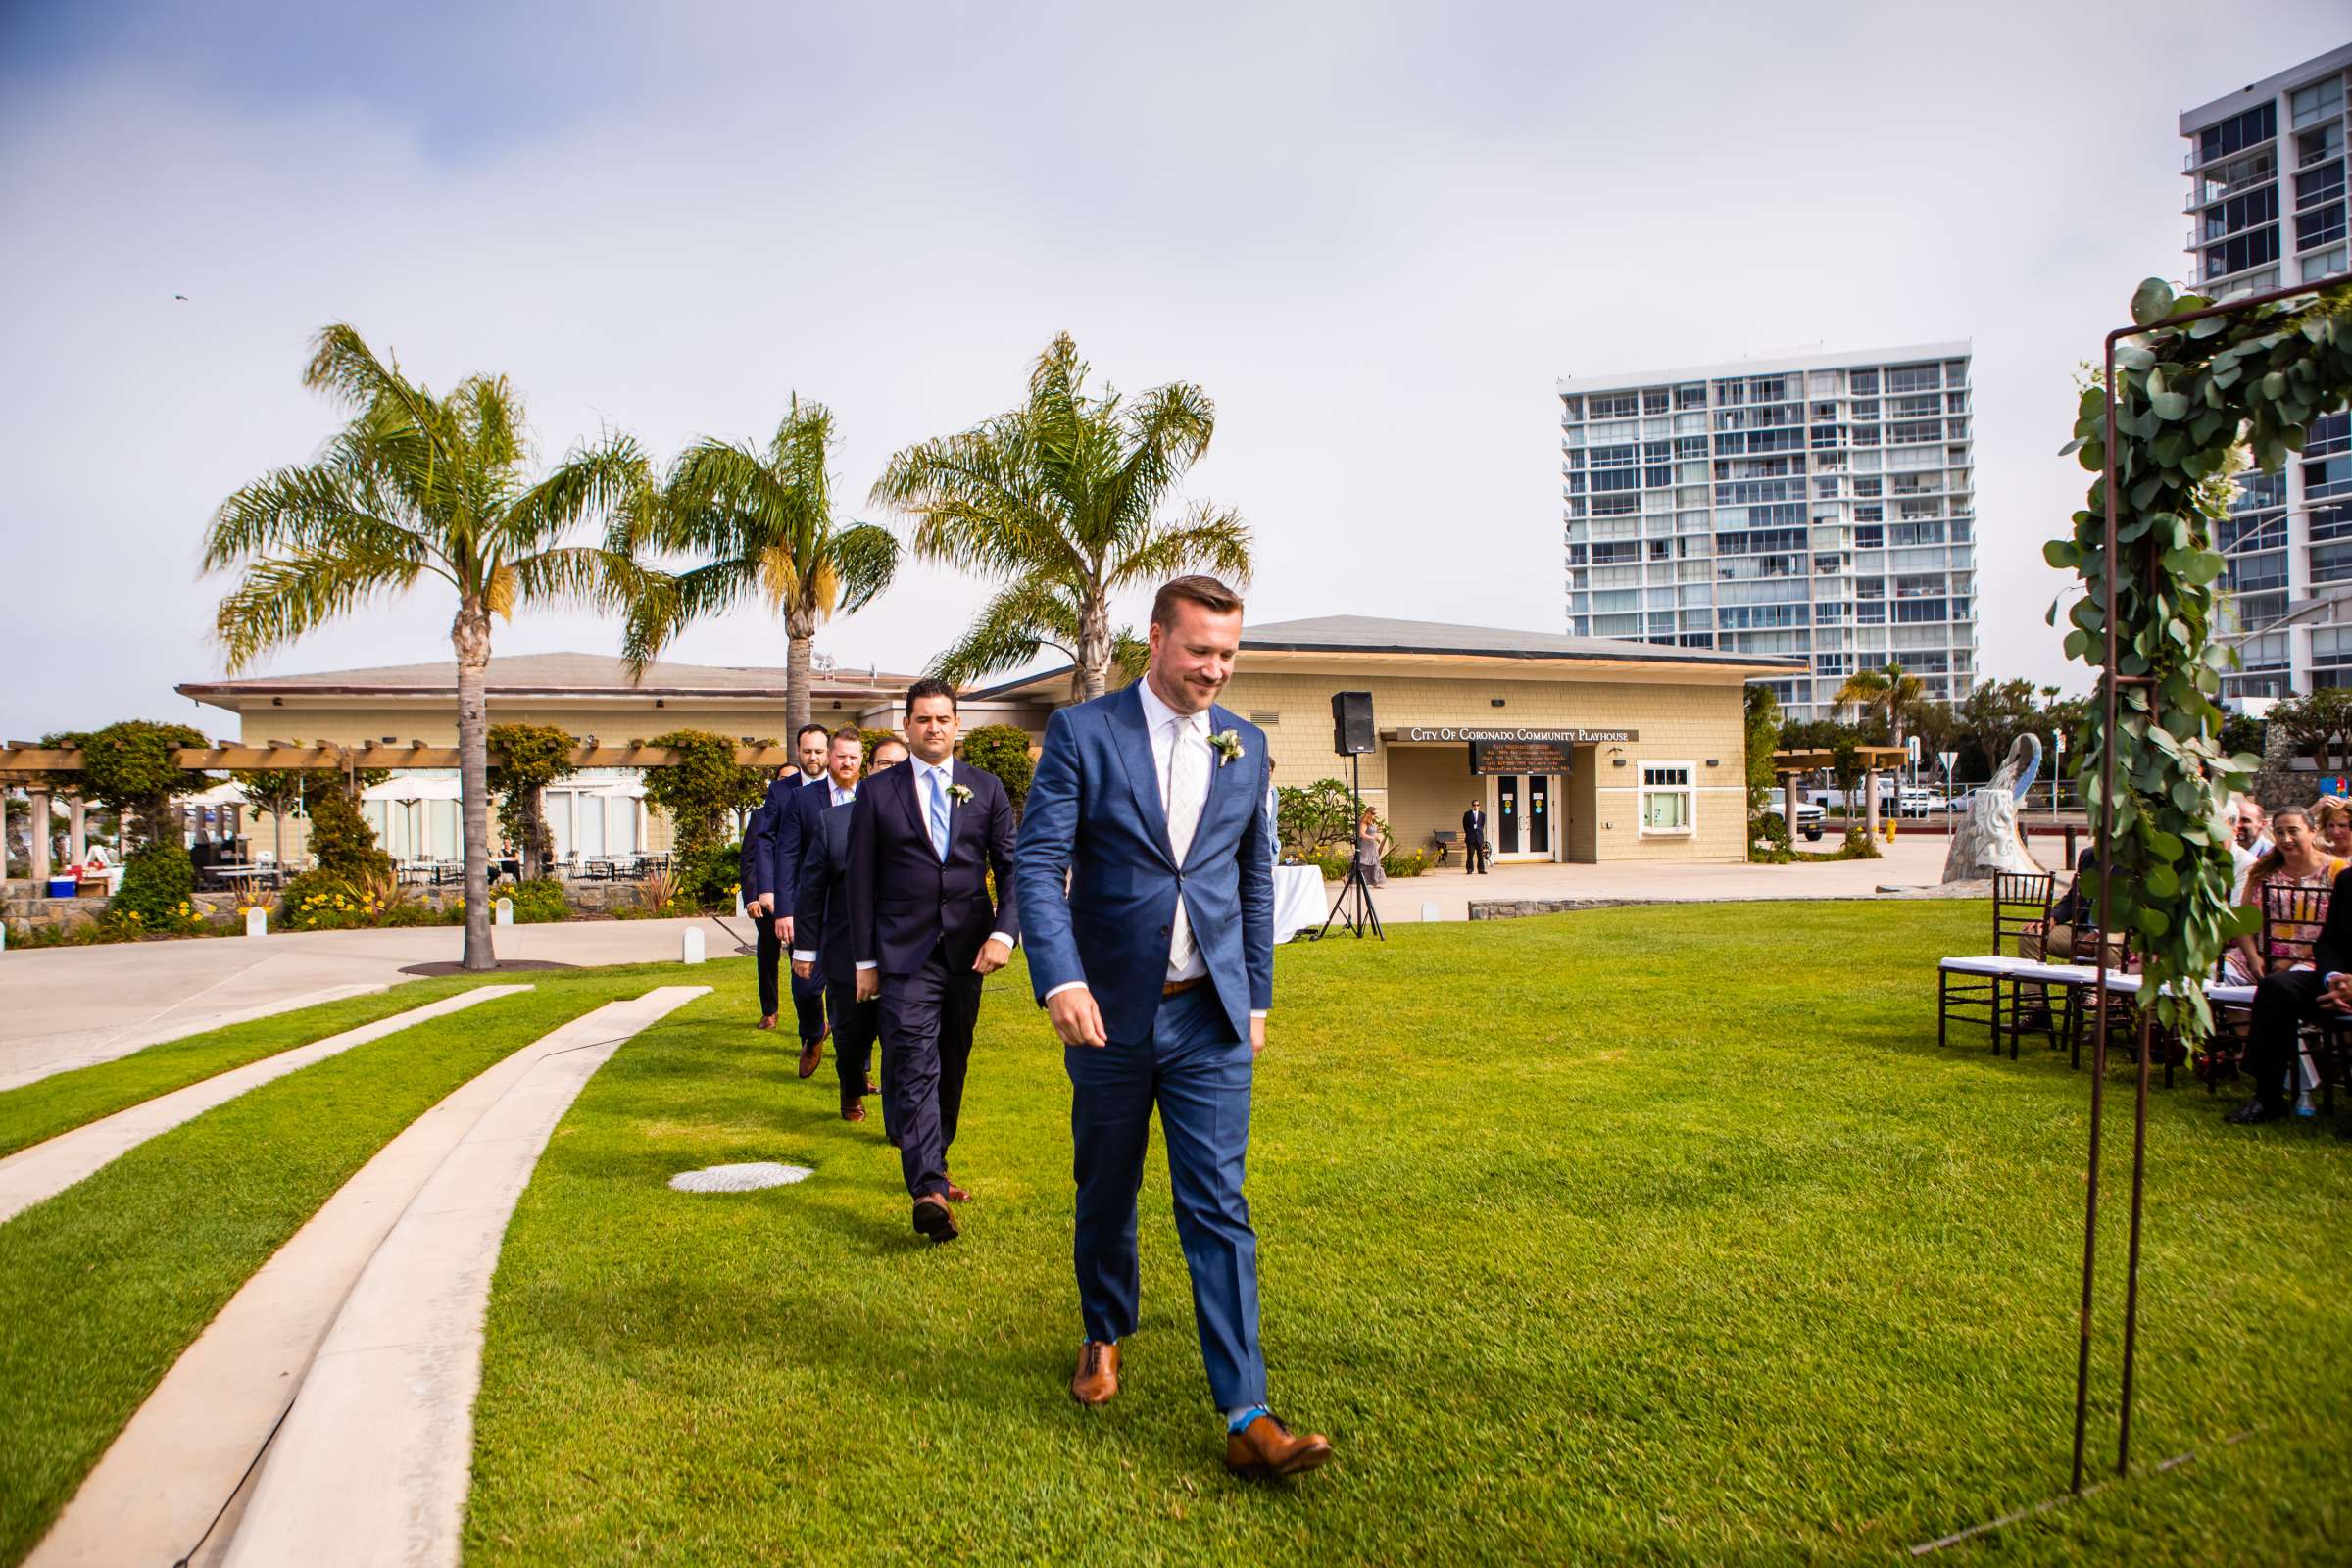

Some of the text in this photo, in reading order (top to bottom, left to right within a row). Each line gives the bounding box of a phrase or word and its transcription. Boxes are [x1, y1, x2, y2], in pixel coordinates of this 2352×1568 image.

[1411, 728, 1628, 742] CITY OF CORONADO COMMUNITY PLAYHOUSE
